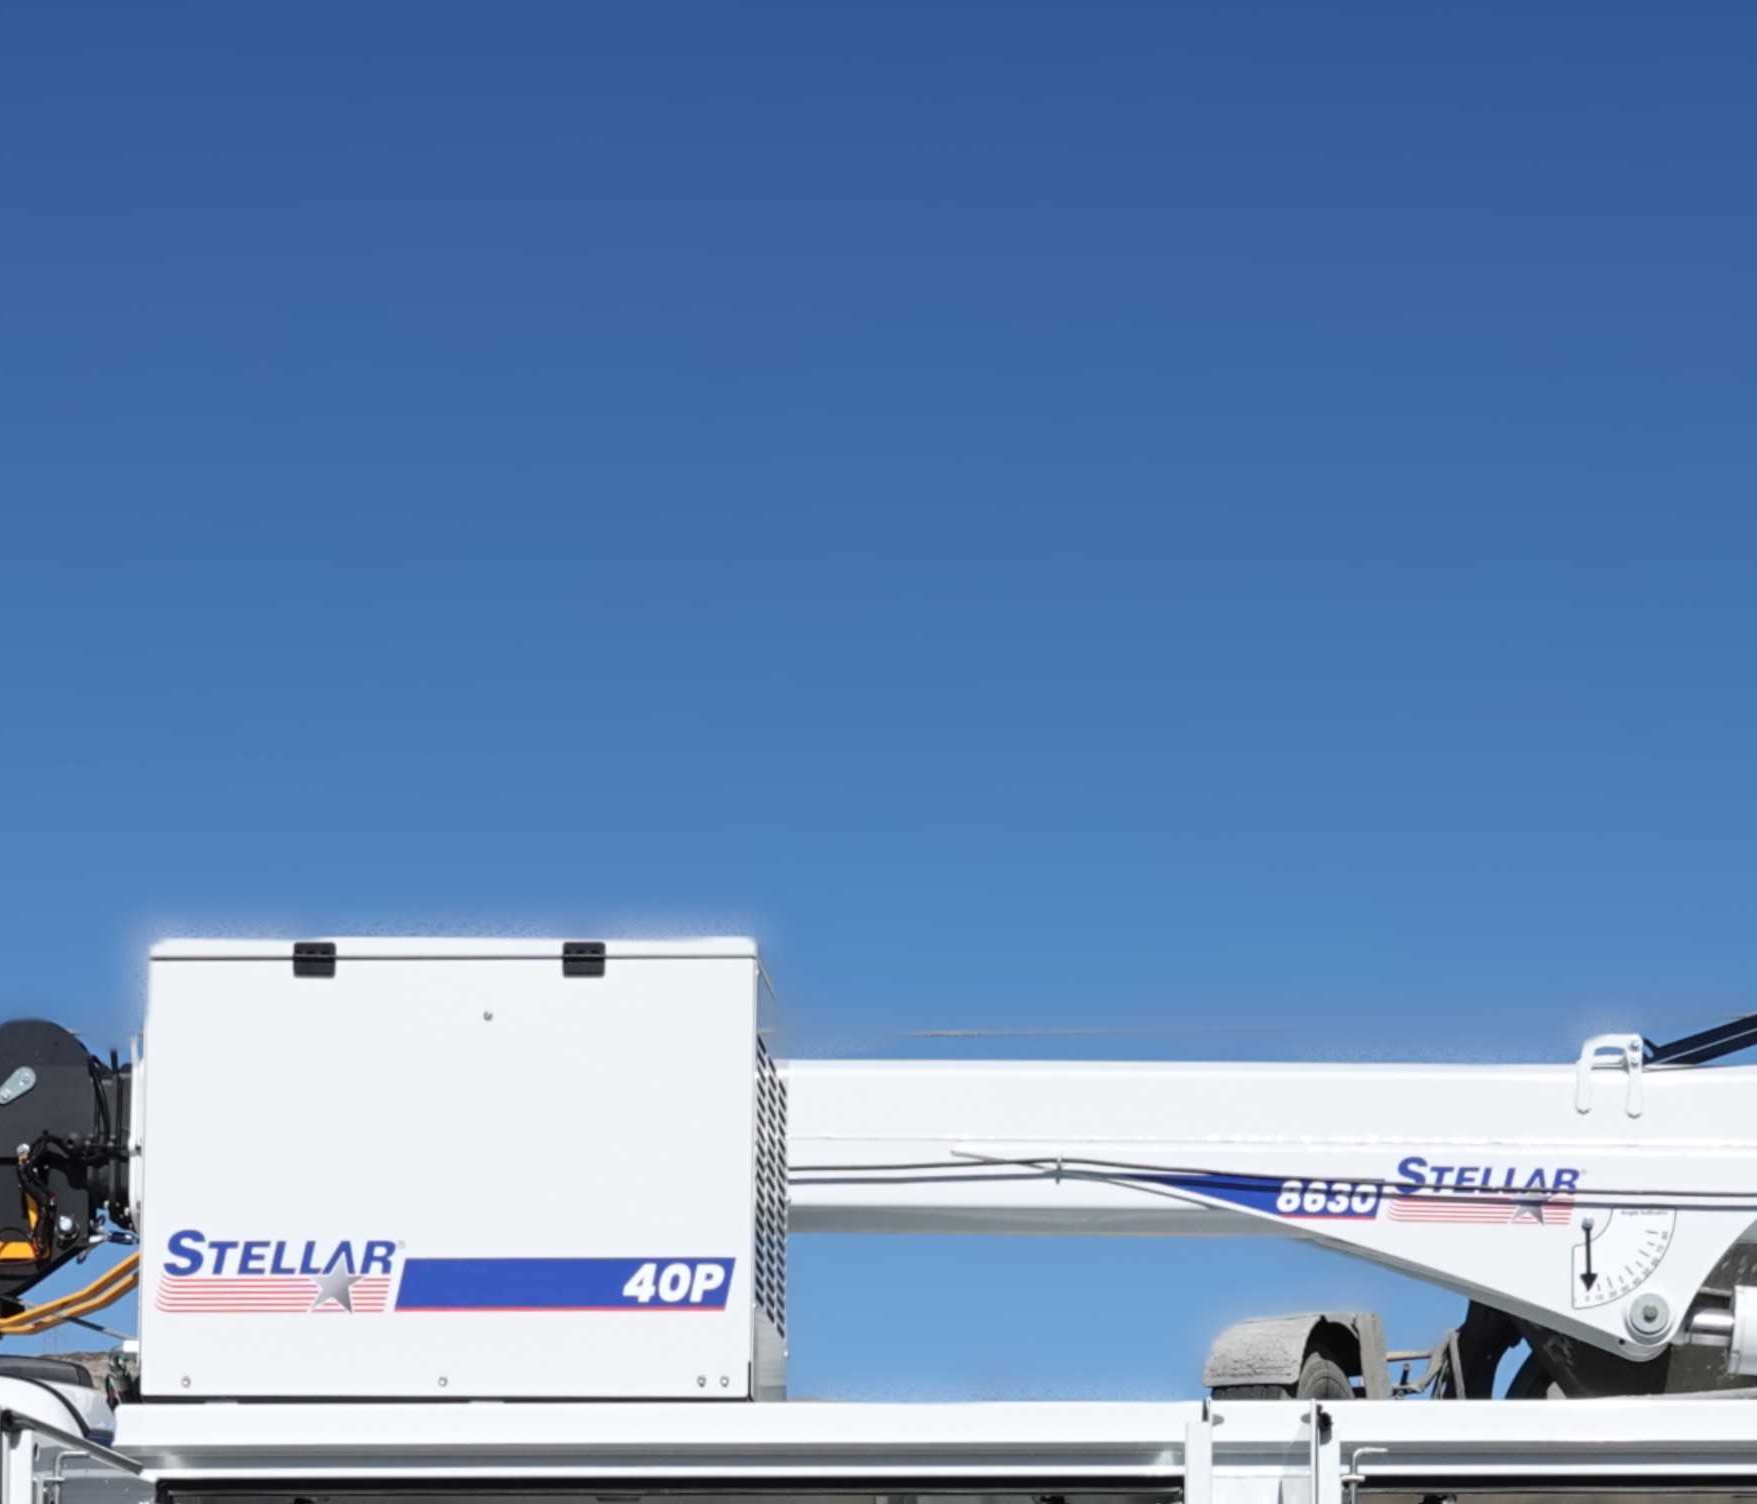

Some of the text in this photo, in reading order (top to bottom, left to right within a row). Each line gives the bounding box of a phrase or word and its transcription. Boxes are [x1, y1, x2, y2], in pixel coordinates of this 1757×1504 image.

[1396, 1156, 1580, 1195] STELLAR
[1276, 1180, 1379, 1214] 8630
[163, 1229, 396, 1277] STELLAR
[623, 1263, 725, 1303] 40P
